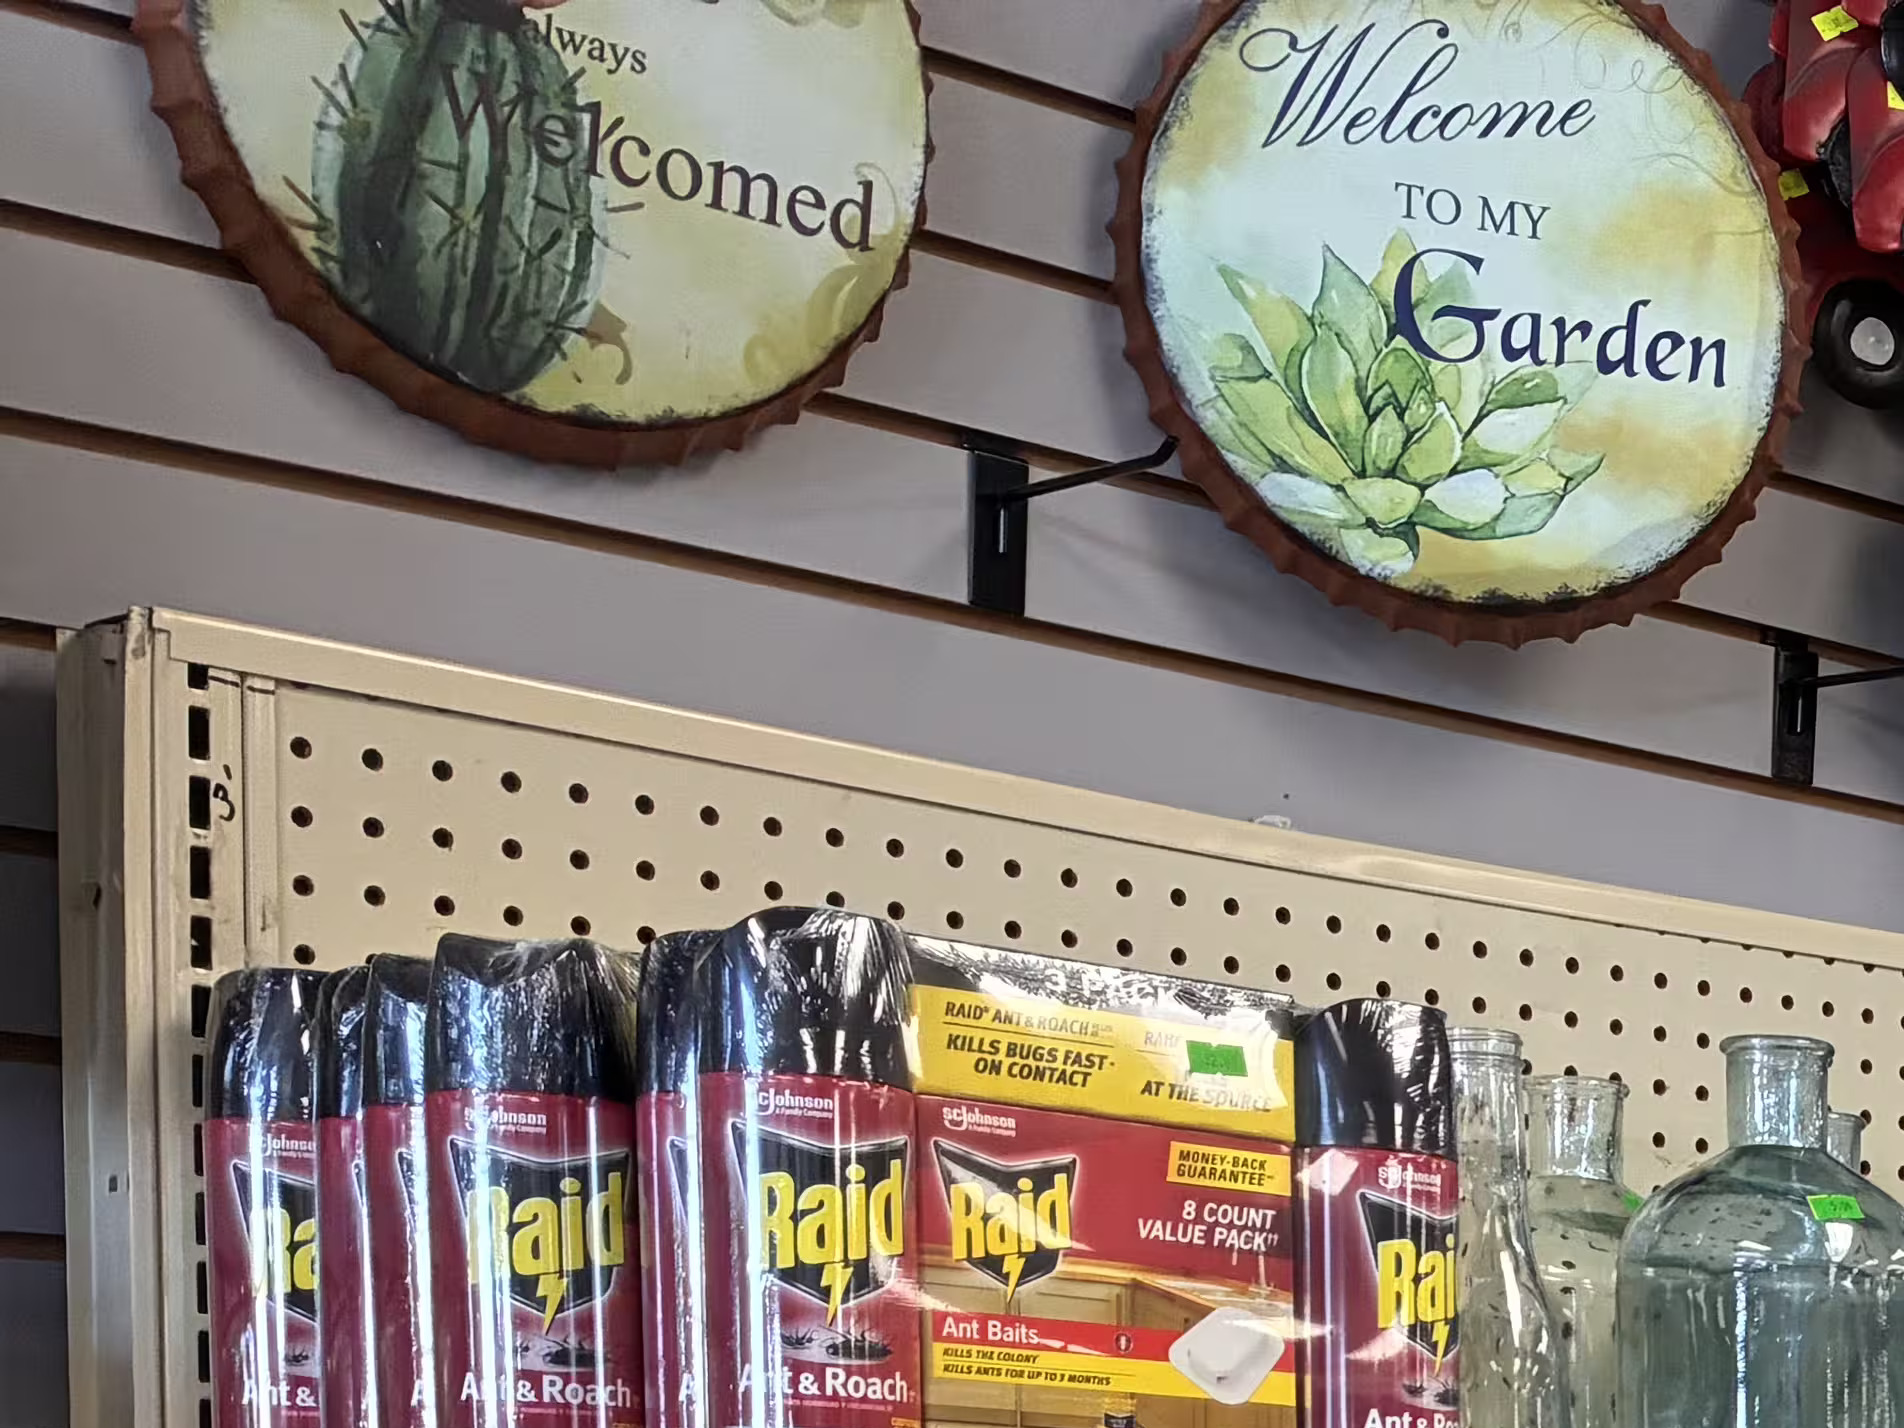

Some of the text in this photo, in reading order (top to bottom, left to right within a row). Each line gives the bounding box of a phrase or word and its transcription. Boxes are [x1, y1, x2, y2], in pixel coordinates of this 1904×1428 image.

[524, 14, 648, 75] always
[1239, 18, 1596, 149] Welcome
[441, 64, 875, 253] Welcomed
[1394, 181, 1552, 241] TO MY
[1392, 247, 1727, 389] Garden
[946, 1033, 1060, 1066] KILLS BUGS
[973, 1056, 1093, 1089] ON CONTACT
[1140, 1080, 1165, 1098] AT
[1177, 1149, 1268, 1173] MONEY-BACK
[756, 1158, 905, 1271] Raid
[949, 1173, 1074, 1262] Raid
[1137, 1218, 1205, 1245] VALUE
[1182, 1199, 1277, 1230] 8 COUNT
[942, 1317, 1040, 1345] Ant Baits
[996, 1352, 1040, 1365] COLONY
[541, 1373, 632, 1408] Roach
[826, 1366, 911, 1403] Roach
[1067, 1373, 1112, 1386] MONTHS
